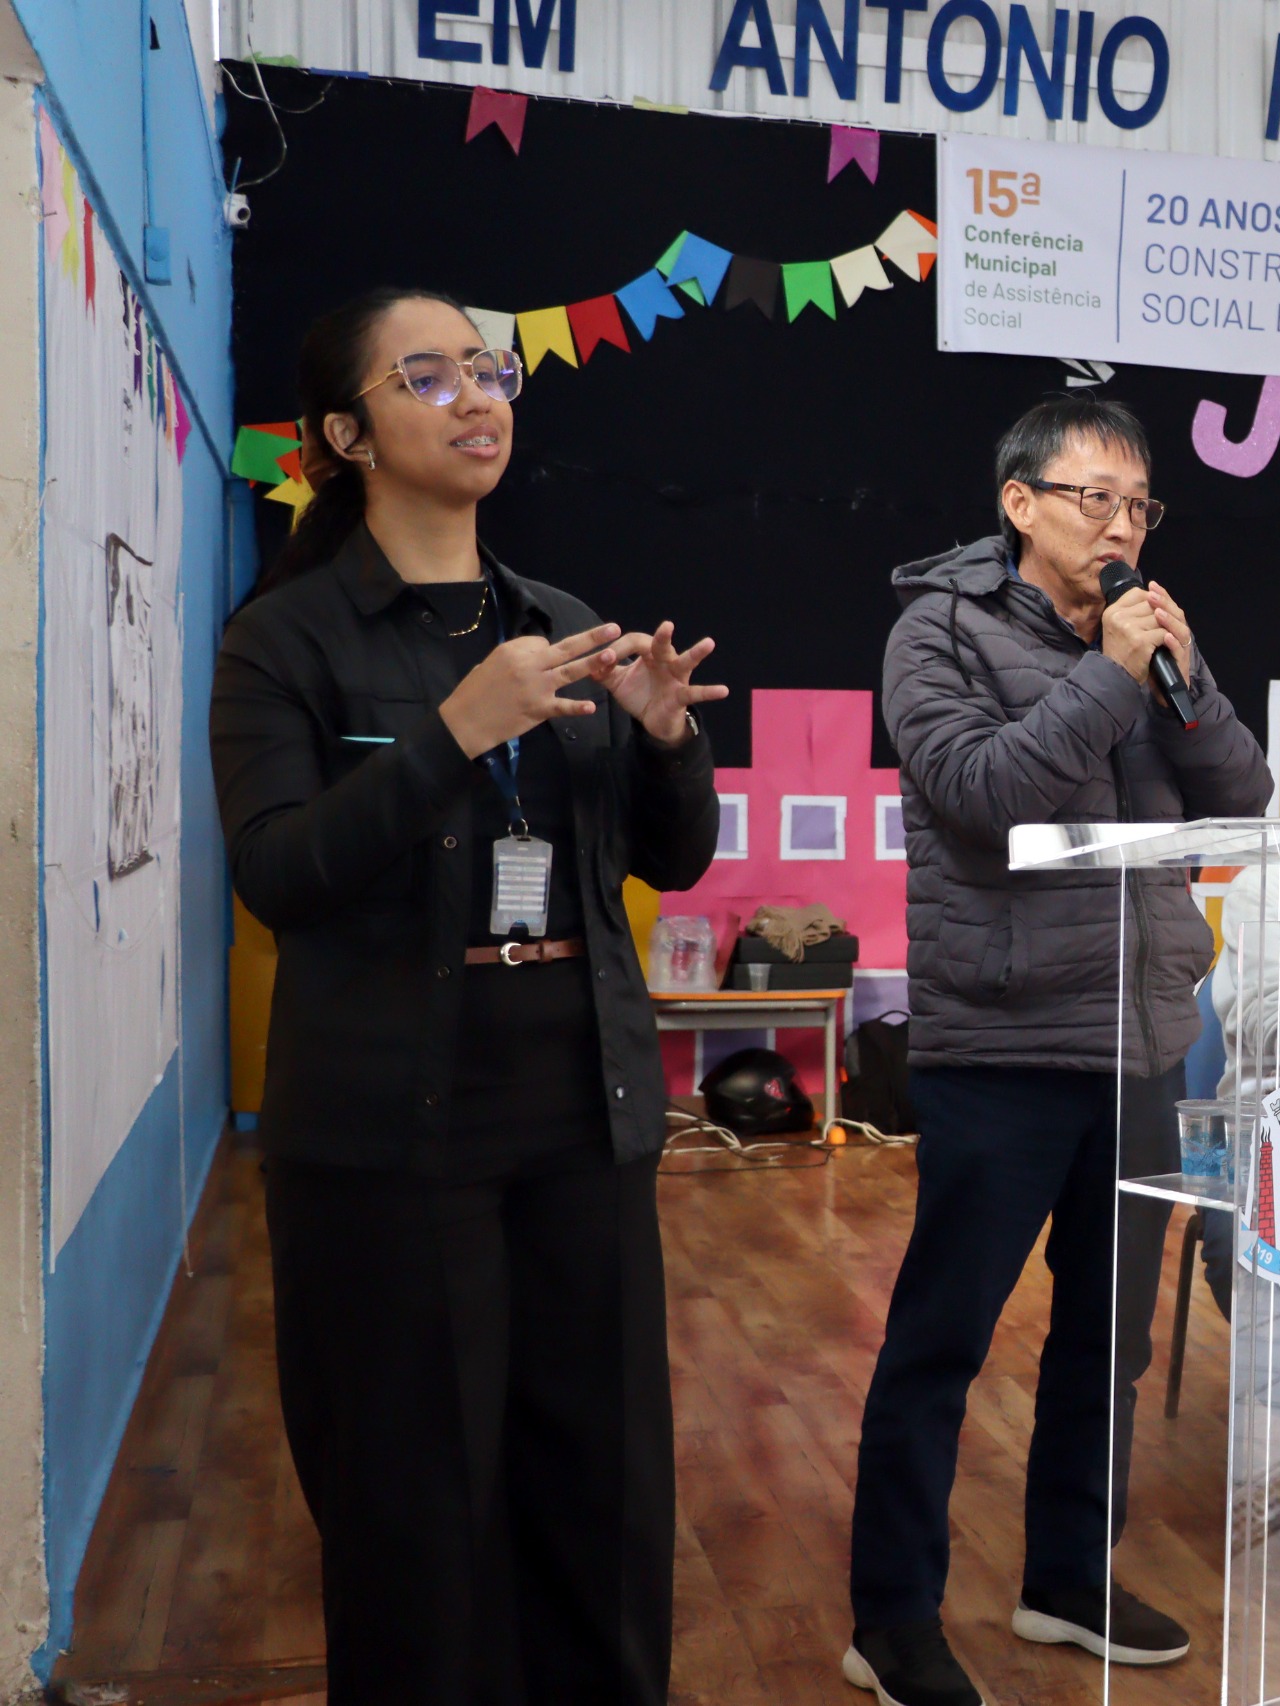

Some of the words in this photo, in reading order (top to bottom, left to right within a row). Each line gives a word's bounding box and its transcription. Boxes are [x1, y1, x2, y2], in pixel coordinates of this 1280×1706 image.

[417, 0, 575, 72] EM
[708, 0, 1169, 130] ANTONIO
[1146, 193, 1189, 225] 20
[964, 225, 1084, 252] Conferência
[964, 252, 1057, 278] Municipal
[964, 280, 988, 299] de
[993, 282, 1102, 309] Assistência
[964, 307, 1022, 329] Social
[1142, 293, 1265, 332] SOCIAL
